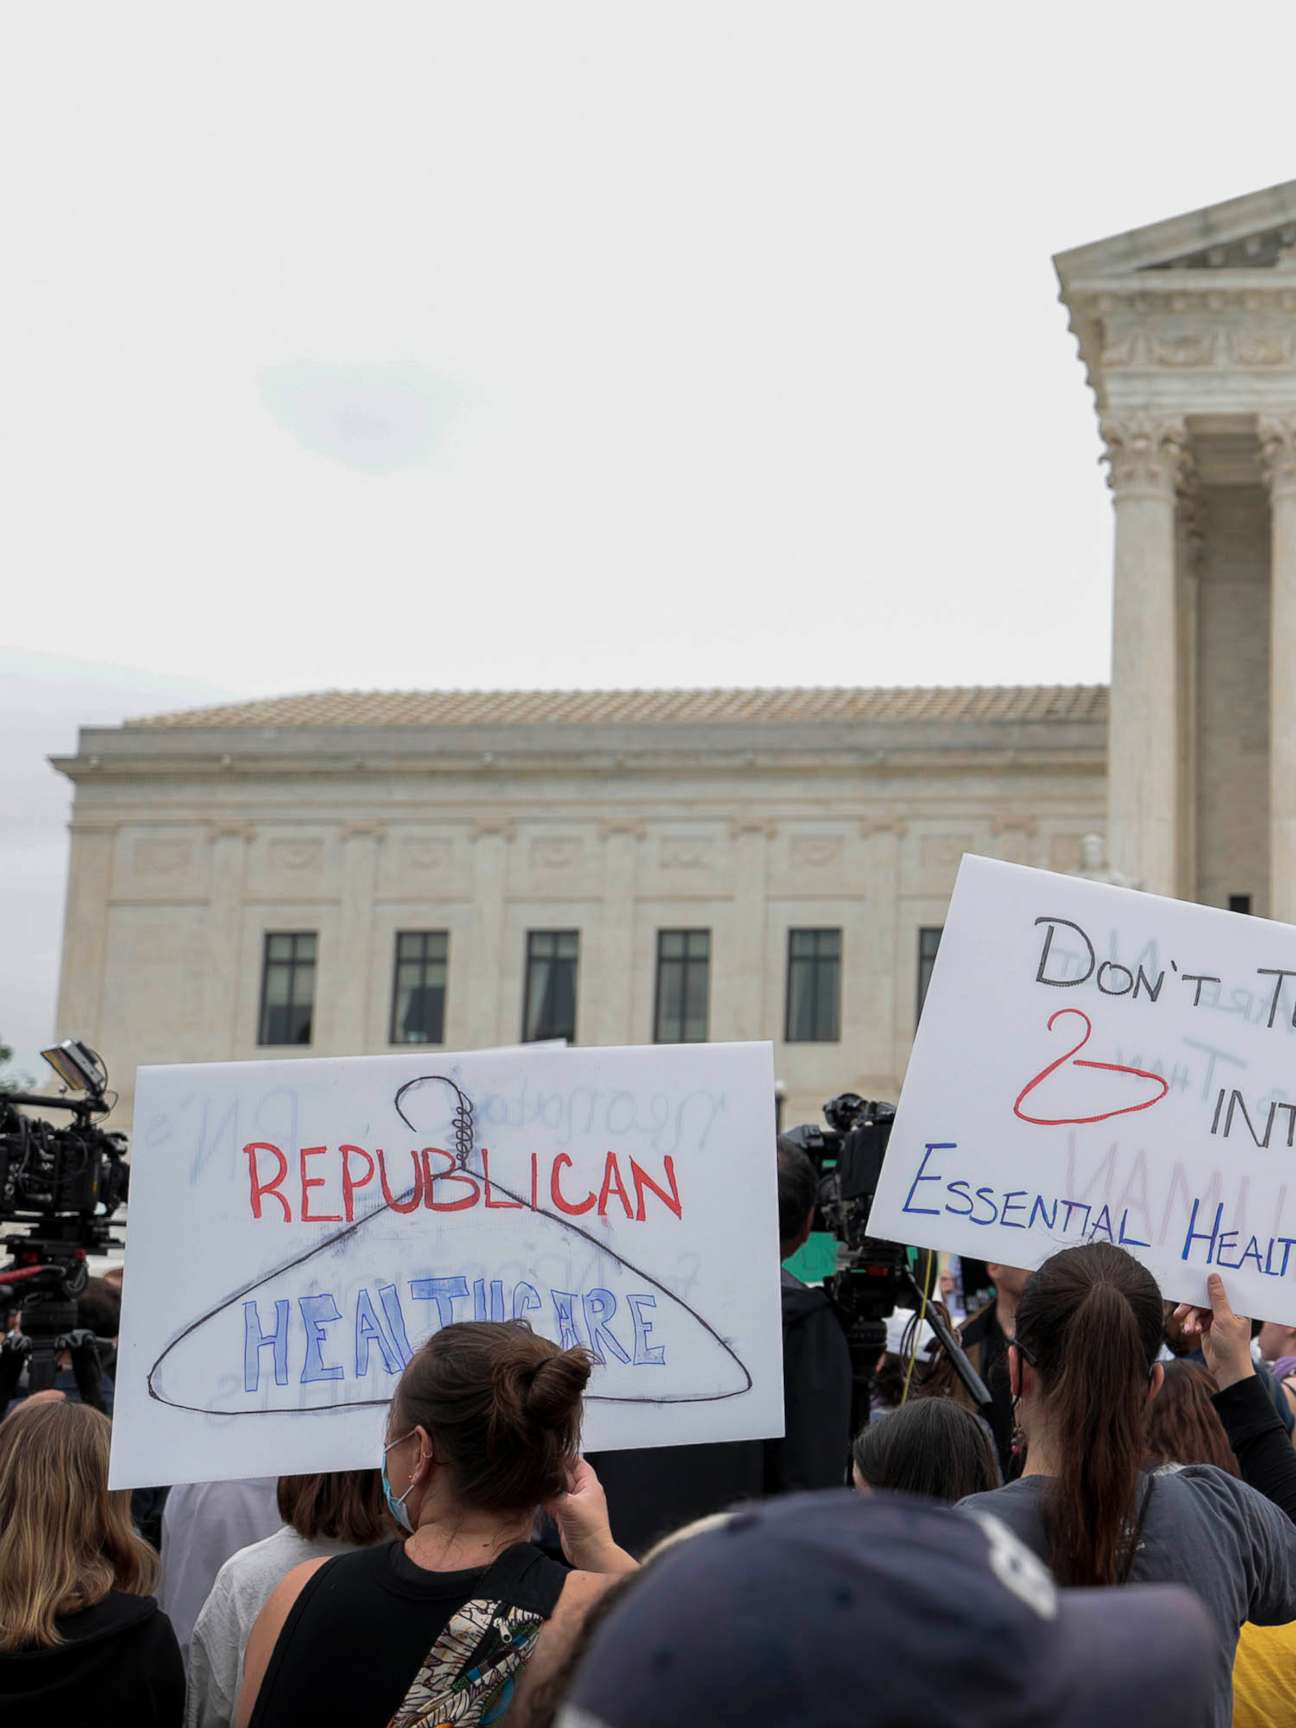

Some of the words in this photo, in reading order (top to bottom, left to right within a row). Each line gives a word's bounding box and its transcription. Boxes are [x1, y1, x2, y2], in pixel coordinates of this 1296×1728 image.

[1034, 917, 1221, 1006] DON'T
[243, 1141, 683, 1222] REPUBLICAN
[902, 1143, 1151, 1247] ESSENTIAL
